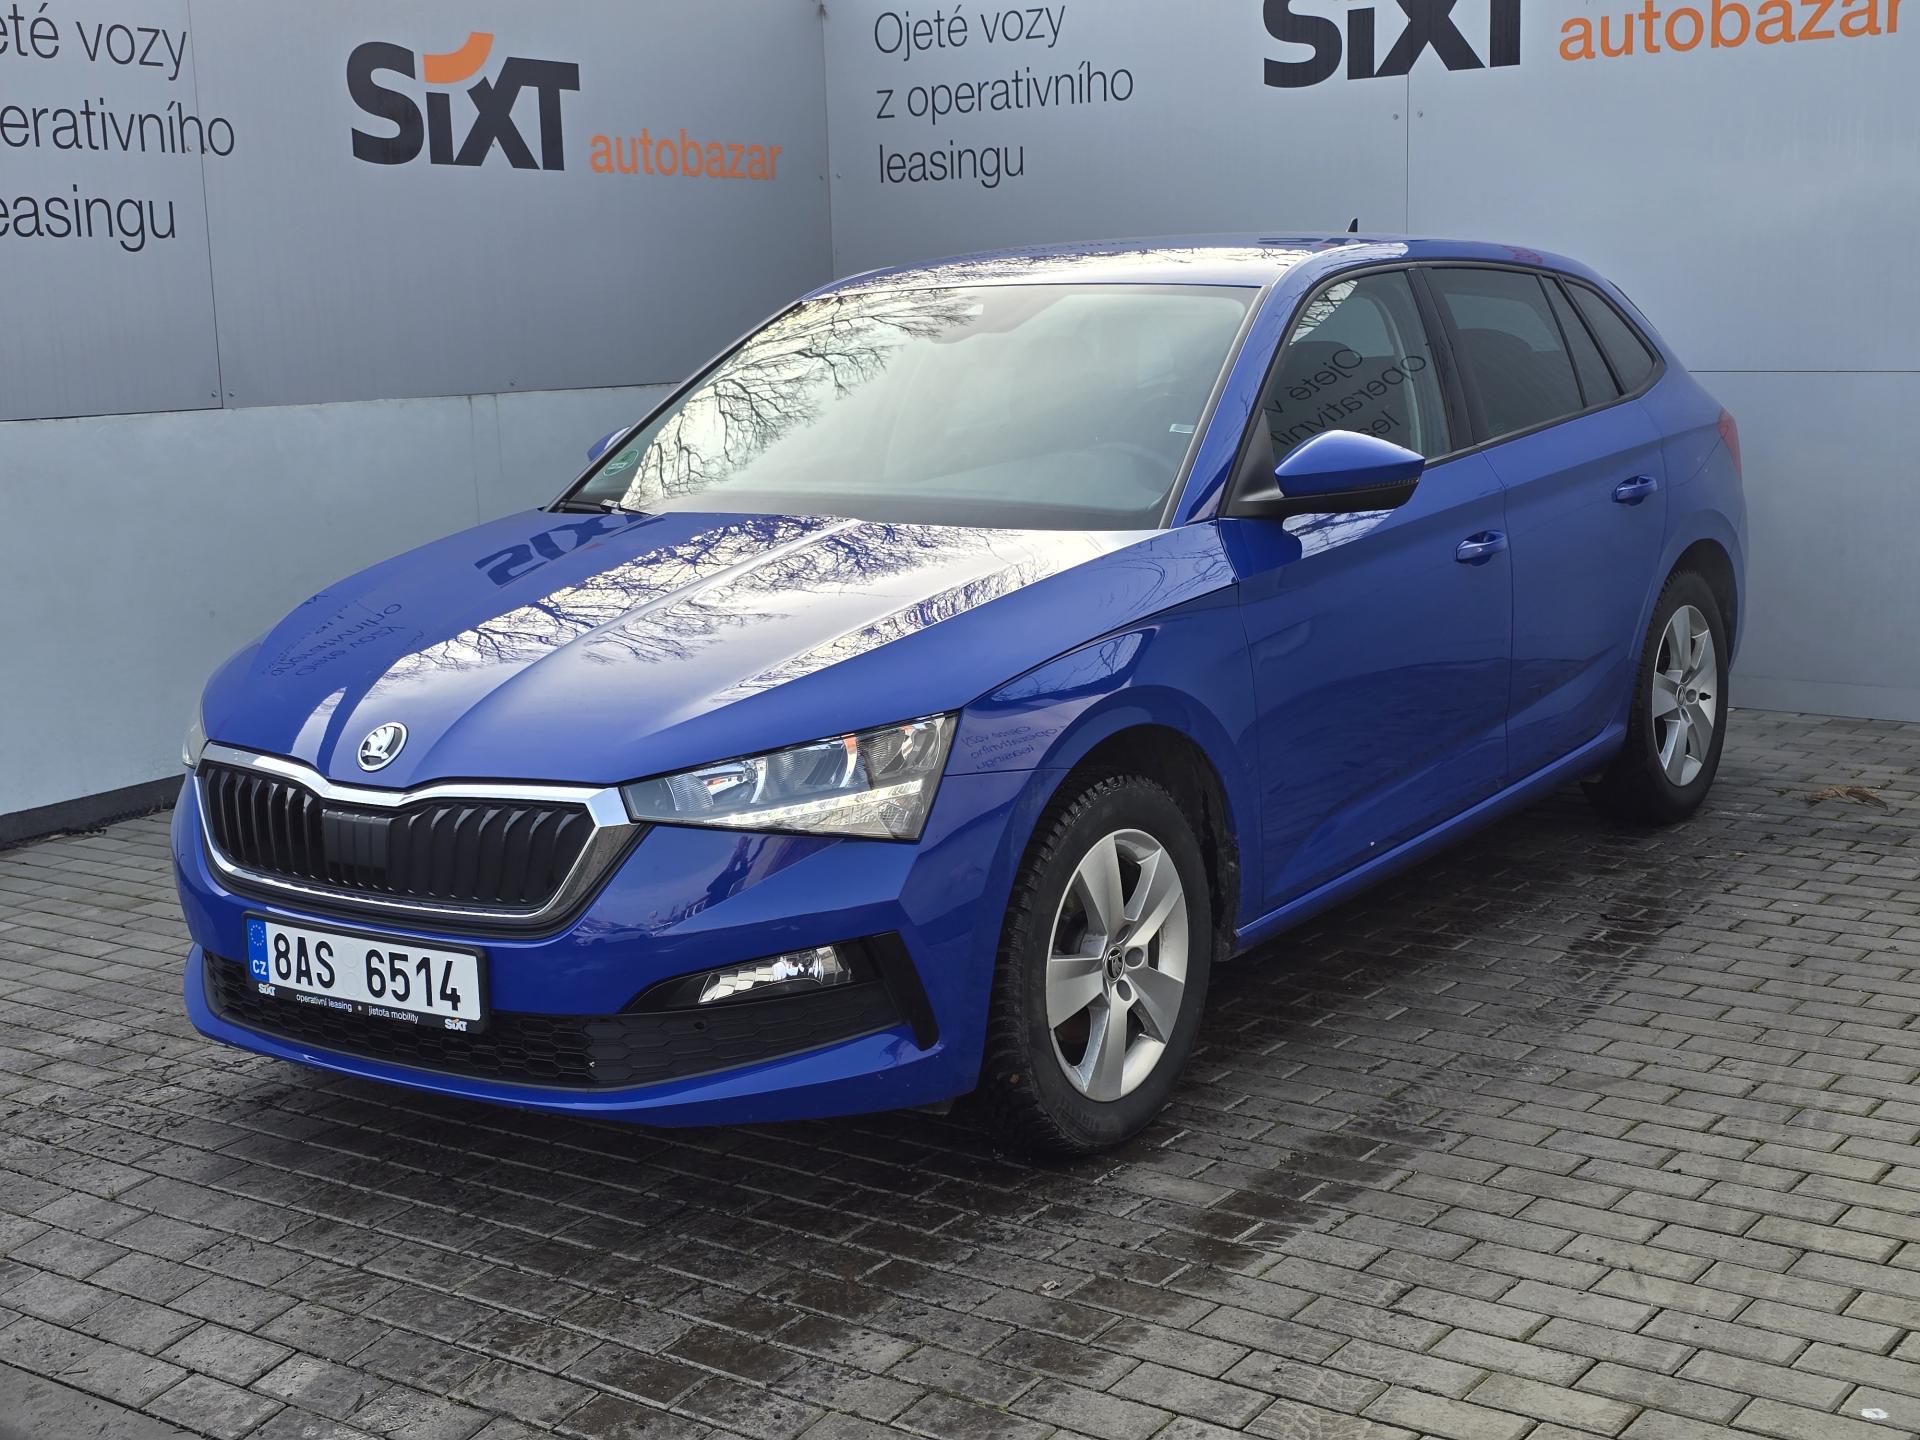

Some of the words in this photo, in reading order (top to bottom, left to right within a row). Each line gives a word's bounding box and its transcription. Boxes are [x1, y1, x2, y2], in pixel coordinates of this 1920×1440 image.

[0, 2, 60, 59] té
[75, 21, 187, 81] vozy
[874, 4, 968, 62] Ojeté
[980, 5, 1065, 48] vozy
[876, 89, 895, 119] z
[907, 60, 1134, 125] operativního
[589, 128, 781, 180] autobazar
[879, 139, 1024, 188] leasingu
[252, 959, 267, 976] CZ
[273, 932, 336, 989] 8AS
[365, 949, 461, 1012] 6514
[328, 998, 353, 1013] leasing
[391, 1010, 419, 1025] mobility
